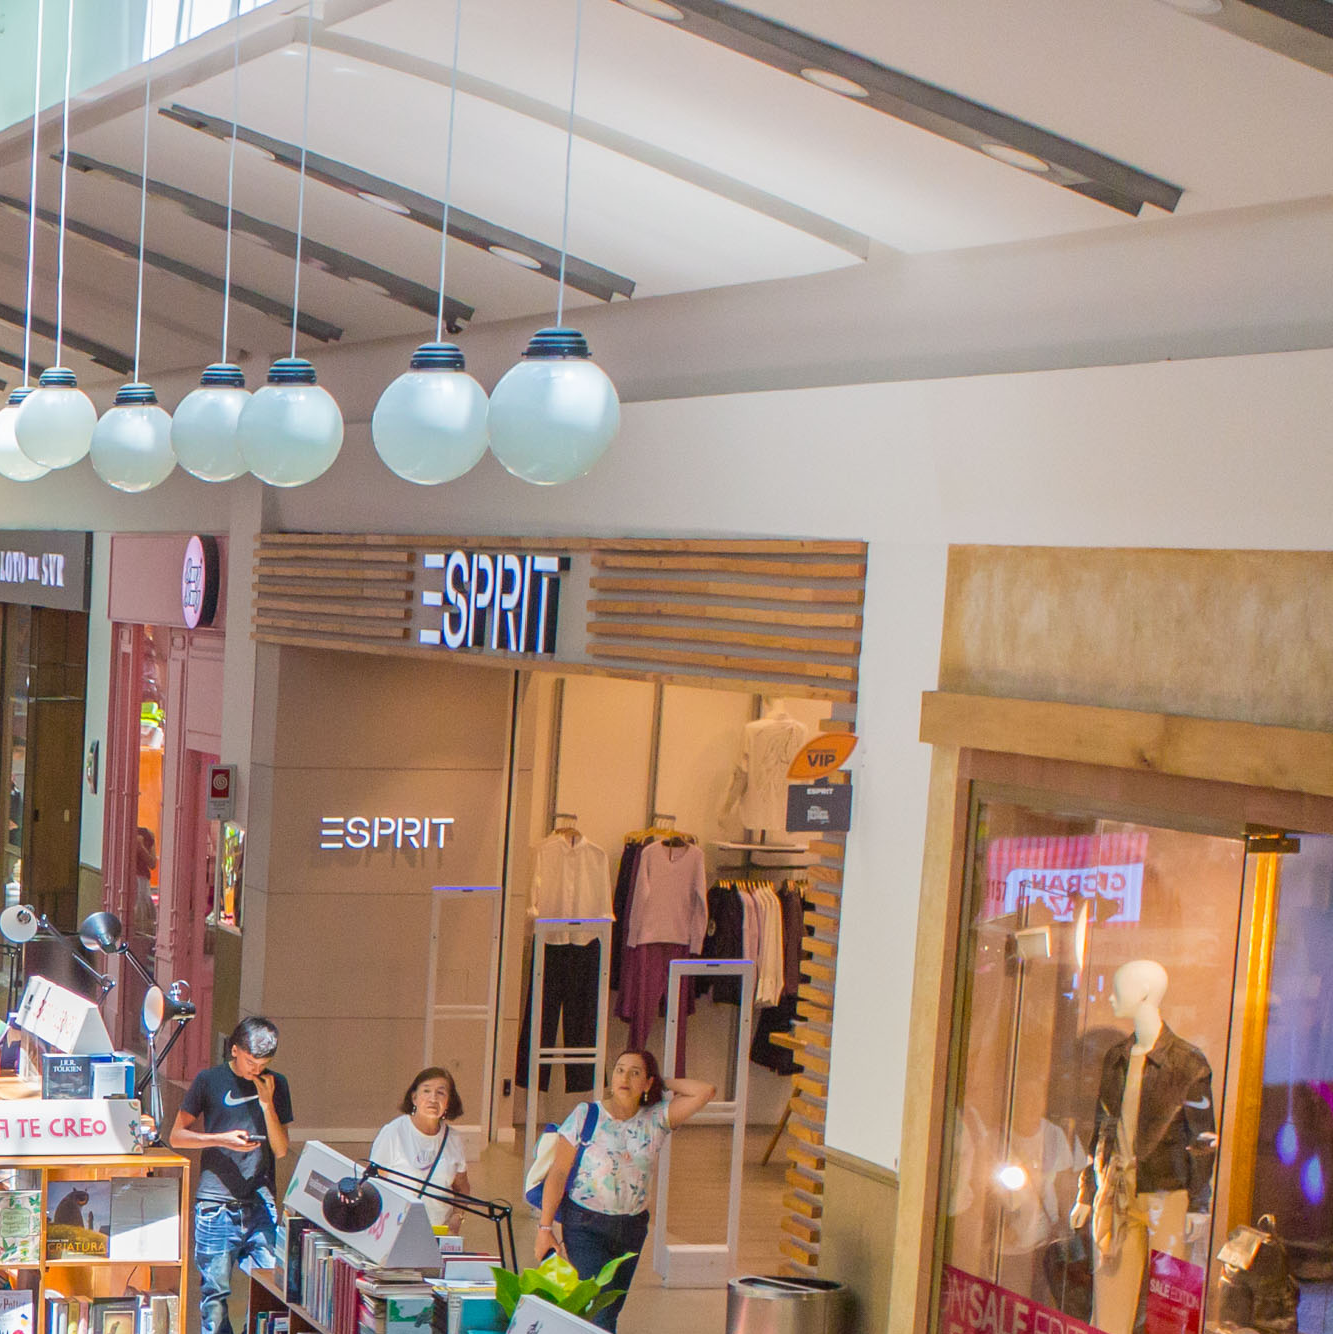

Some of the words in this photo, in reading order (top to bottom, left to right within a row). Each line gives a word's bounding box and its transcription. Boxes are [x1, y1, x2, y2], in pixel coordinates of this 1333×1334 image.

[0, 551, 25, 583] LOTO
[419, 549, 559, 654] ESPRIT
[807, 753, 836, 768] VIP
[320, 817, 455, 849] ESPRIT
[17, 1118, 42, 1137] TE
[47, 1240, 106, 1251] CRIATURA
[1149, 1278, 1171, 1298] SALE
